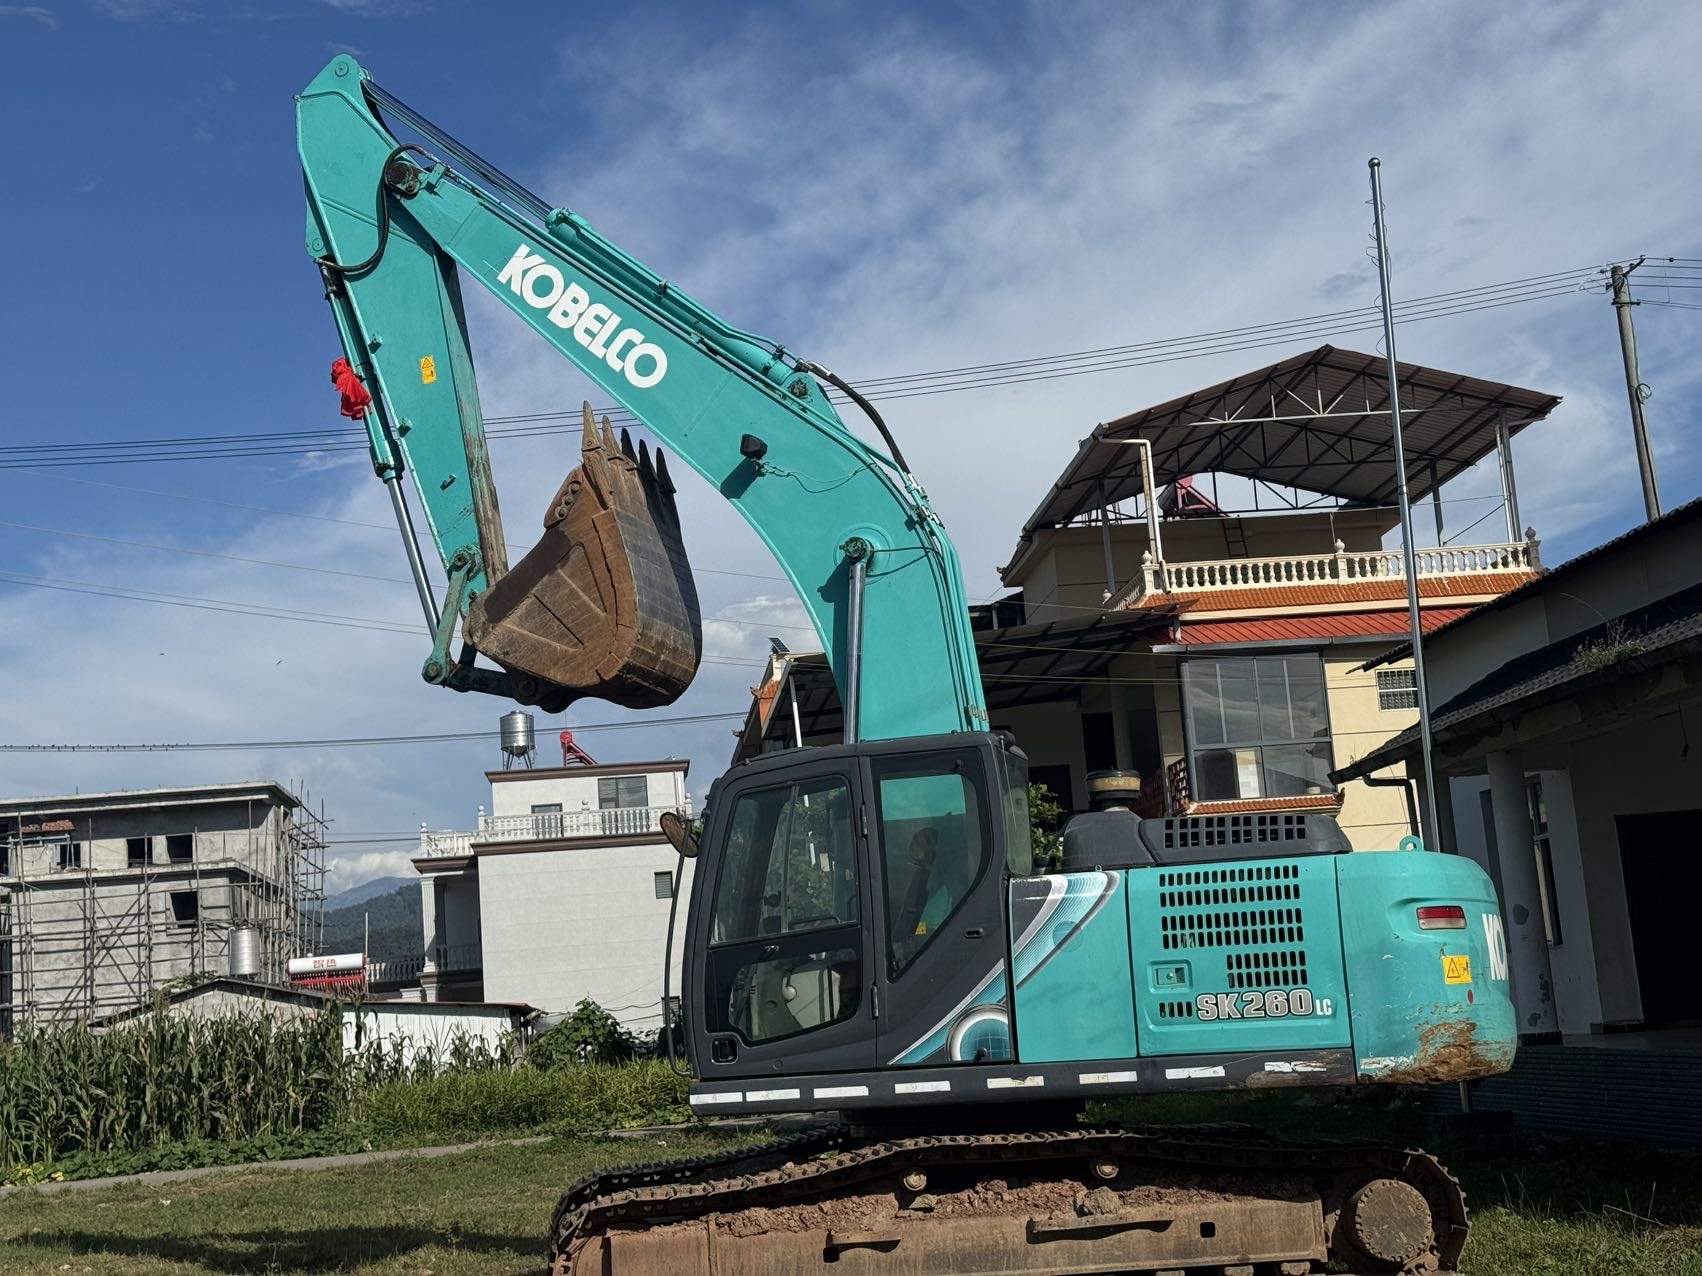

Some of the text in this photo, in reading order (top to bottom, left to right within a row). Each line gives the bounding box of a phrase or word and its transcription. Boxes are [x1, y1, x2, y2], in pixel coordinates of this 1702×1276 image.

[496, 243, 668, 388] KOBELCO
[1481, 913, 1509, 980] KO
[1196, 988, 1332, 1021] SK260 LC
